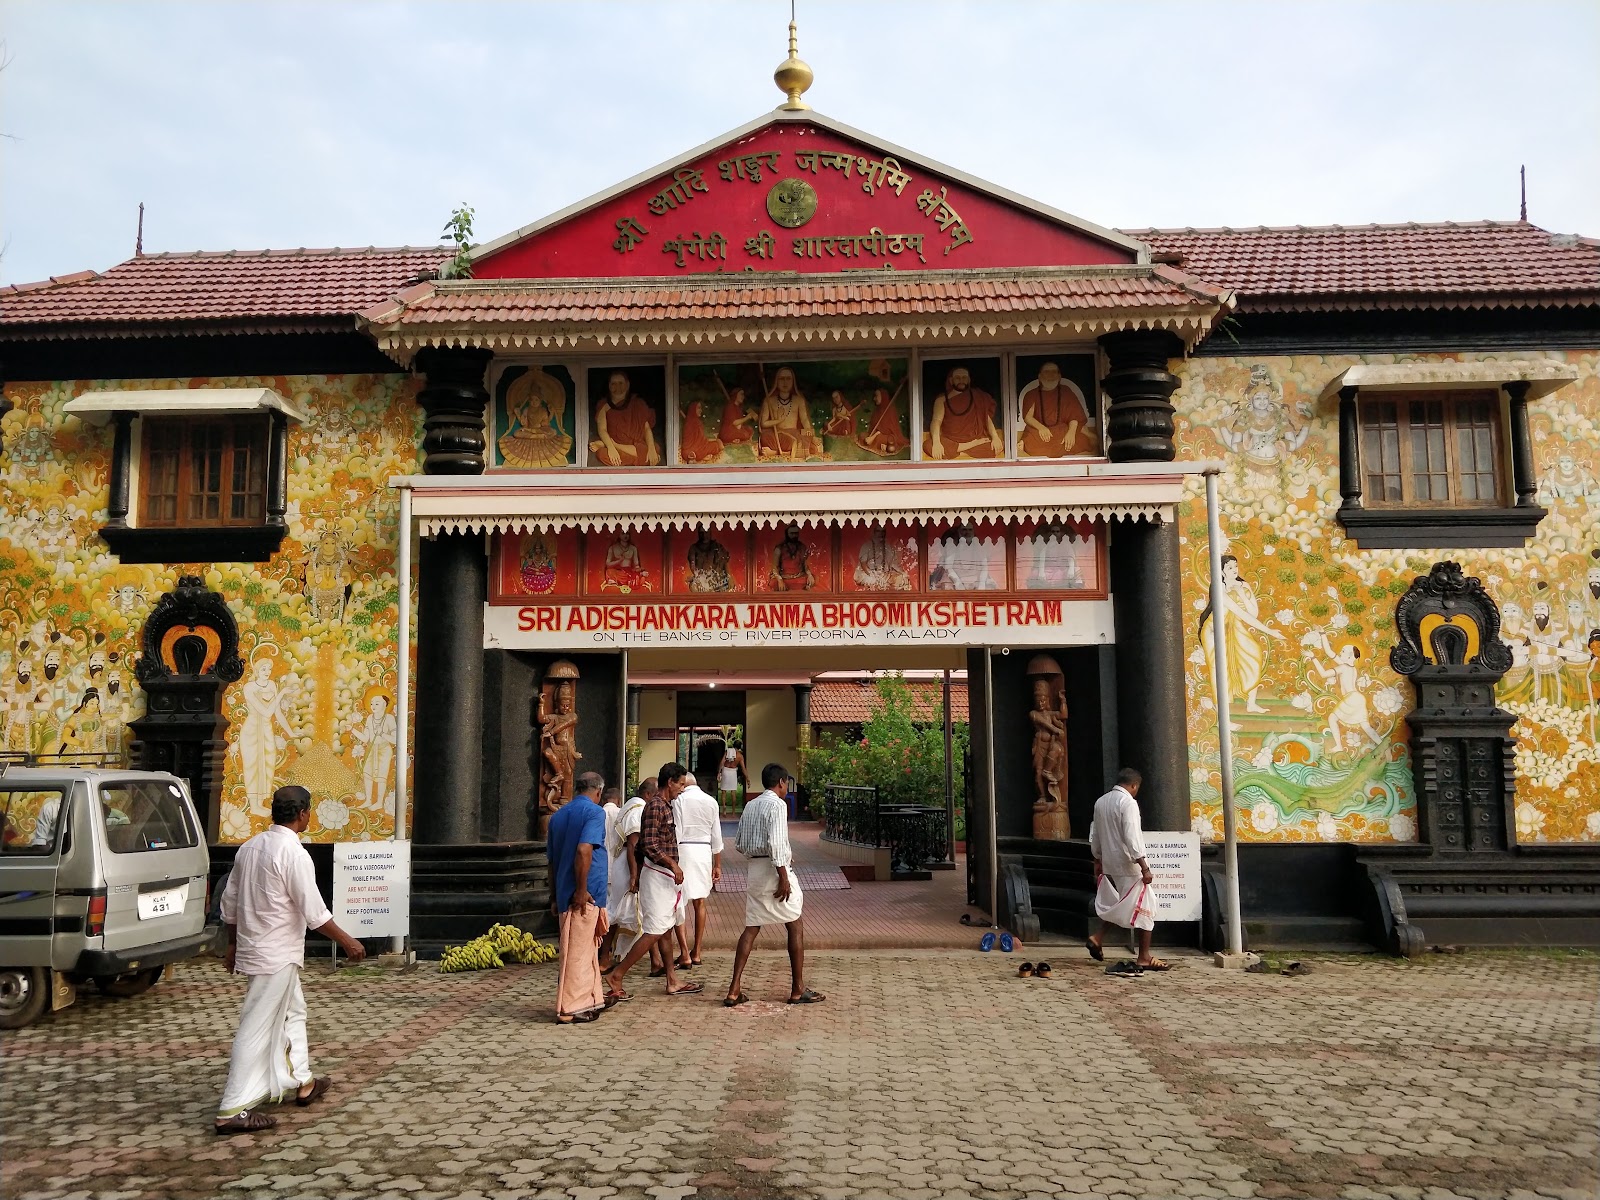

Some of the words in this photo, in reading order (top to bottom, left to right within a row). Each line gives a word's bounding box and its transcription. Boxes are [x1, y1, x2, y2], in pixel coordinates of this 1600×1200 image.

[613, 216, 649, 253] श्री
[647, 168, 709, 215] आदि
[744, 230, 776, 259] श्री
[518, 606, 561, 632] SRI
[565, 604, 740, 631] ADISHANKARA
[743, 603, 818, 629] JANMA
[822, 602, 912, 629] BHOOMI
[917, 600, 1062, 627] KSHETRAM
[593, 632, 615, 642] ON
[621, 632, 652, 642] THE
[659, 631, 712, 642] BANKS
[719, 630, 739, 641] OF
[746, 630, 792, 641] RIVER
[799, 629, 867, 640] POORNA
[886, 628, 961, 640] KALADY
[152, 904, 170, 912] 431
